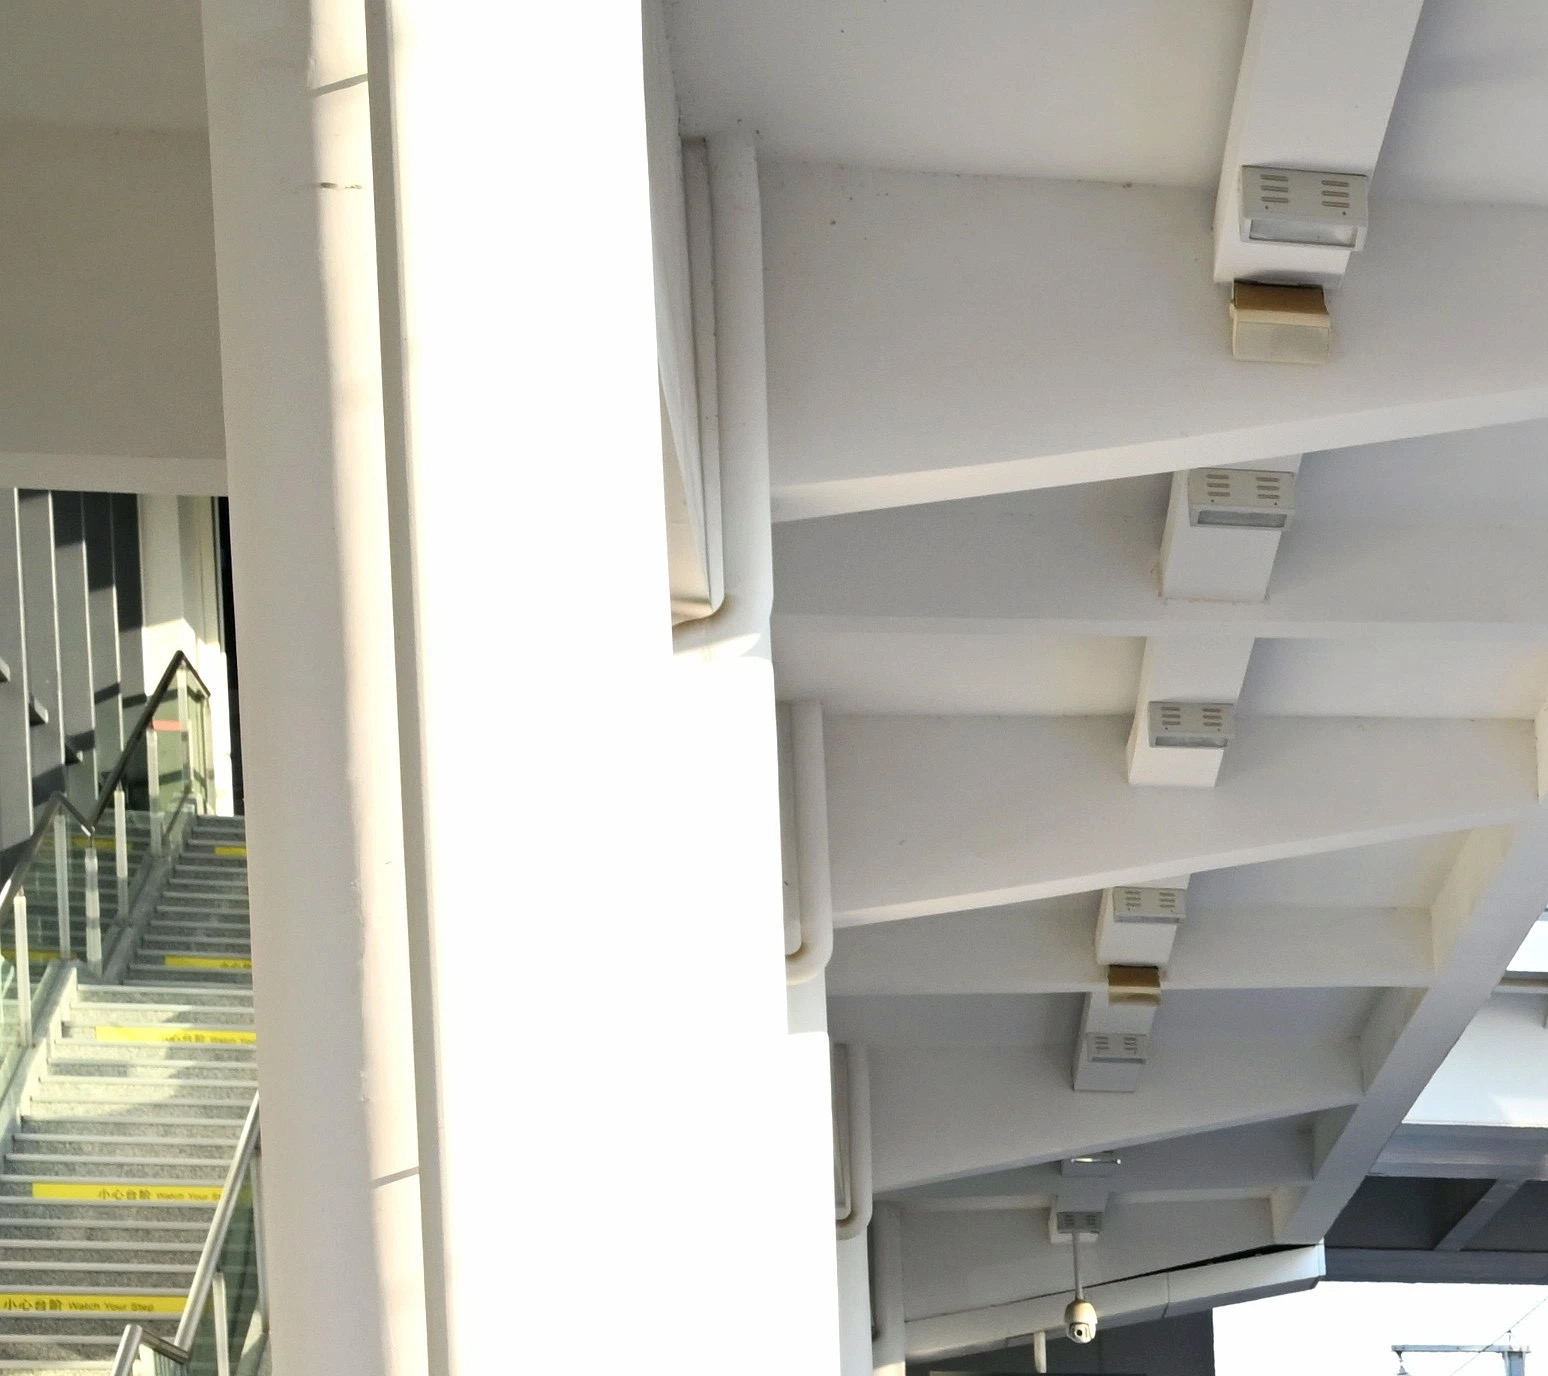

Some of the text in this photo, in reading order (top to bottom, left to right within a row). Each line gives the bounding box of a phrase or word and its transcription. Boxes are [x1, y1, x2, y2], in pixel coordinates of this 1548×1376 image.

[98, 1188, 150, 1200] 小心台阶
[3, 1298, 155, 1312] 小心台阶 Watch Your Step
